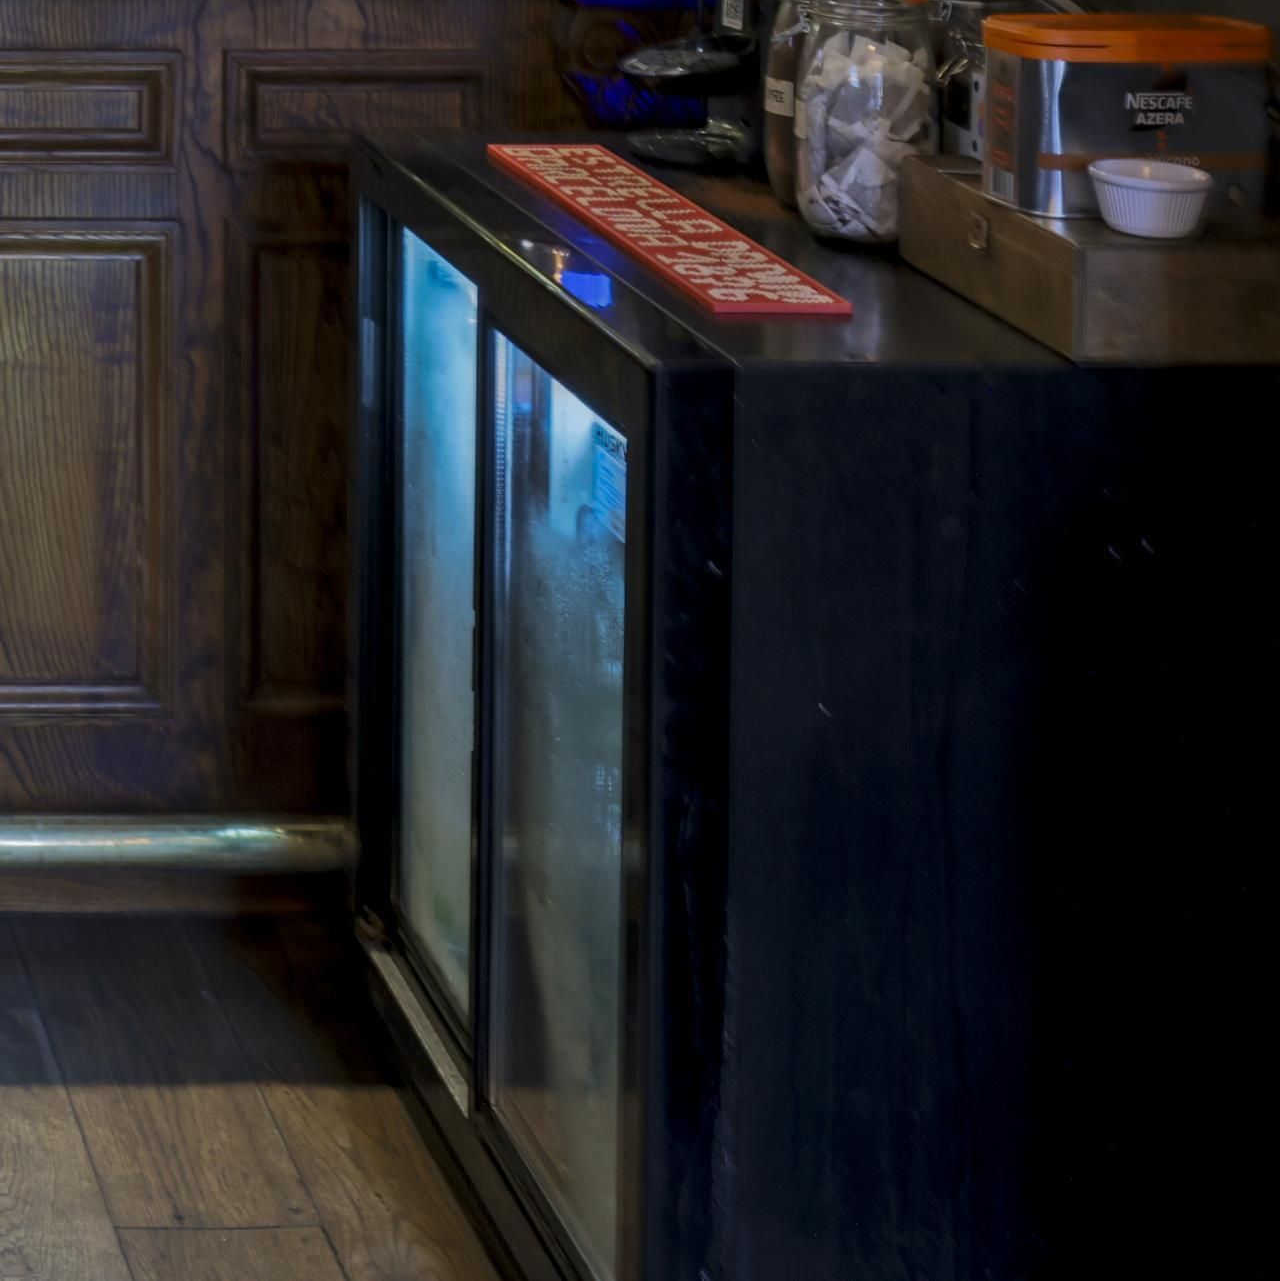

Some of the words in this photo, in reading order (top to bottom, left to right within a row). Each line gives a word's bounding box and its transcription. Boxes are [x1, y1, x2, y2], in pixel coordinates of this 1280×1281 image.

[1135, 112, 1184, 126] AZERA
[498, 146, 698, 246] BARCELONA
[551, 147, 729, 233] ESTRELLA
[683, 239, 842, 304] DAMM
